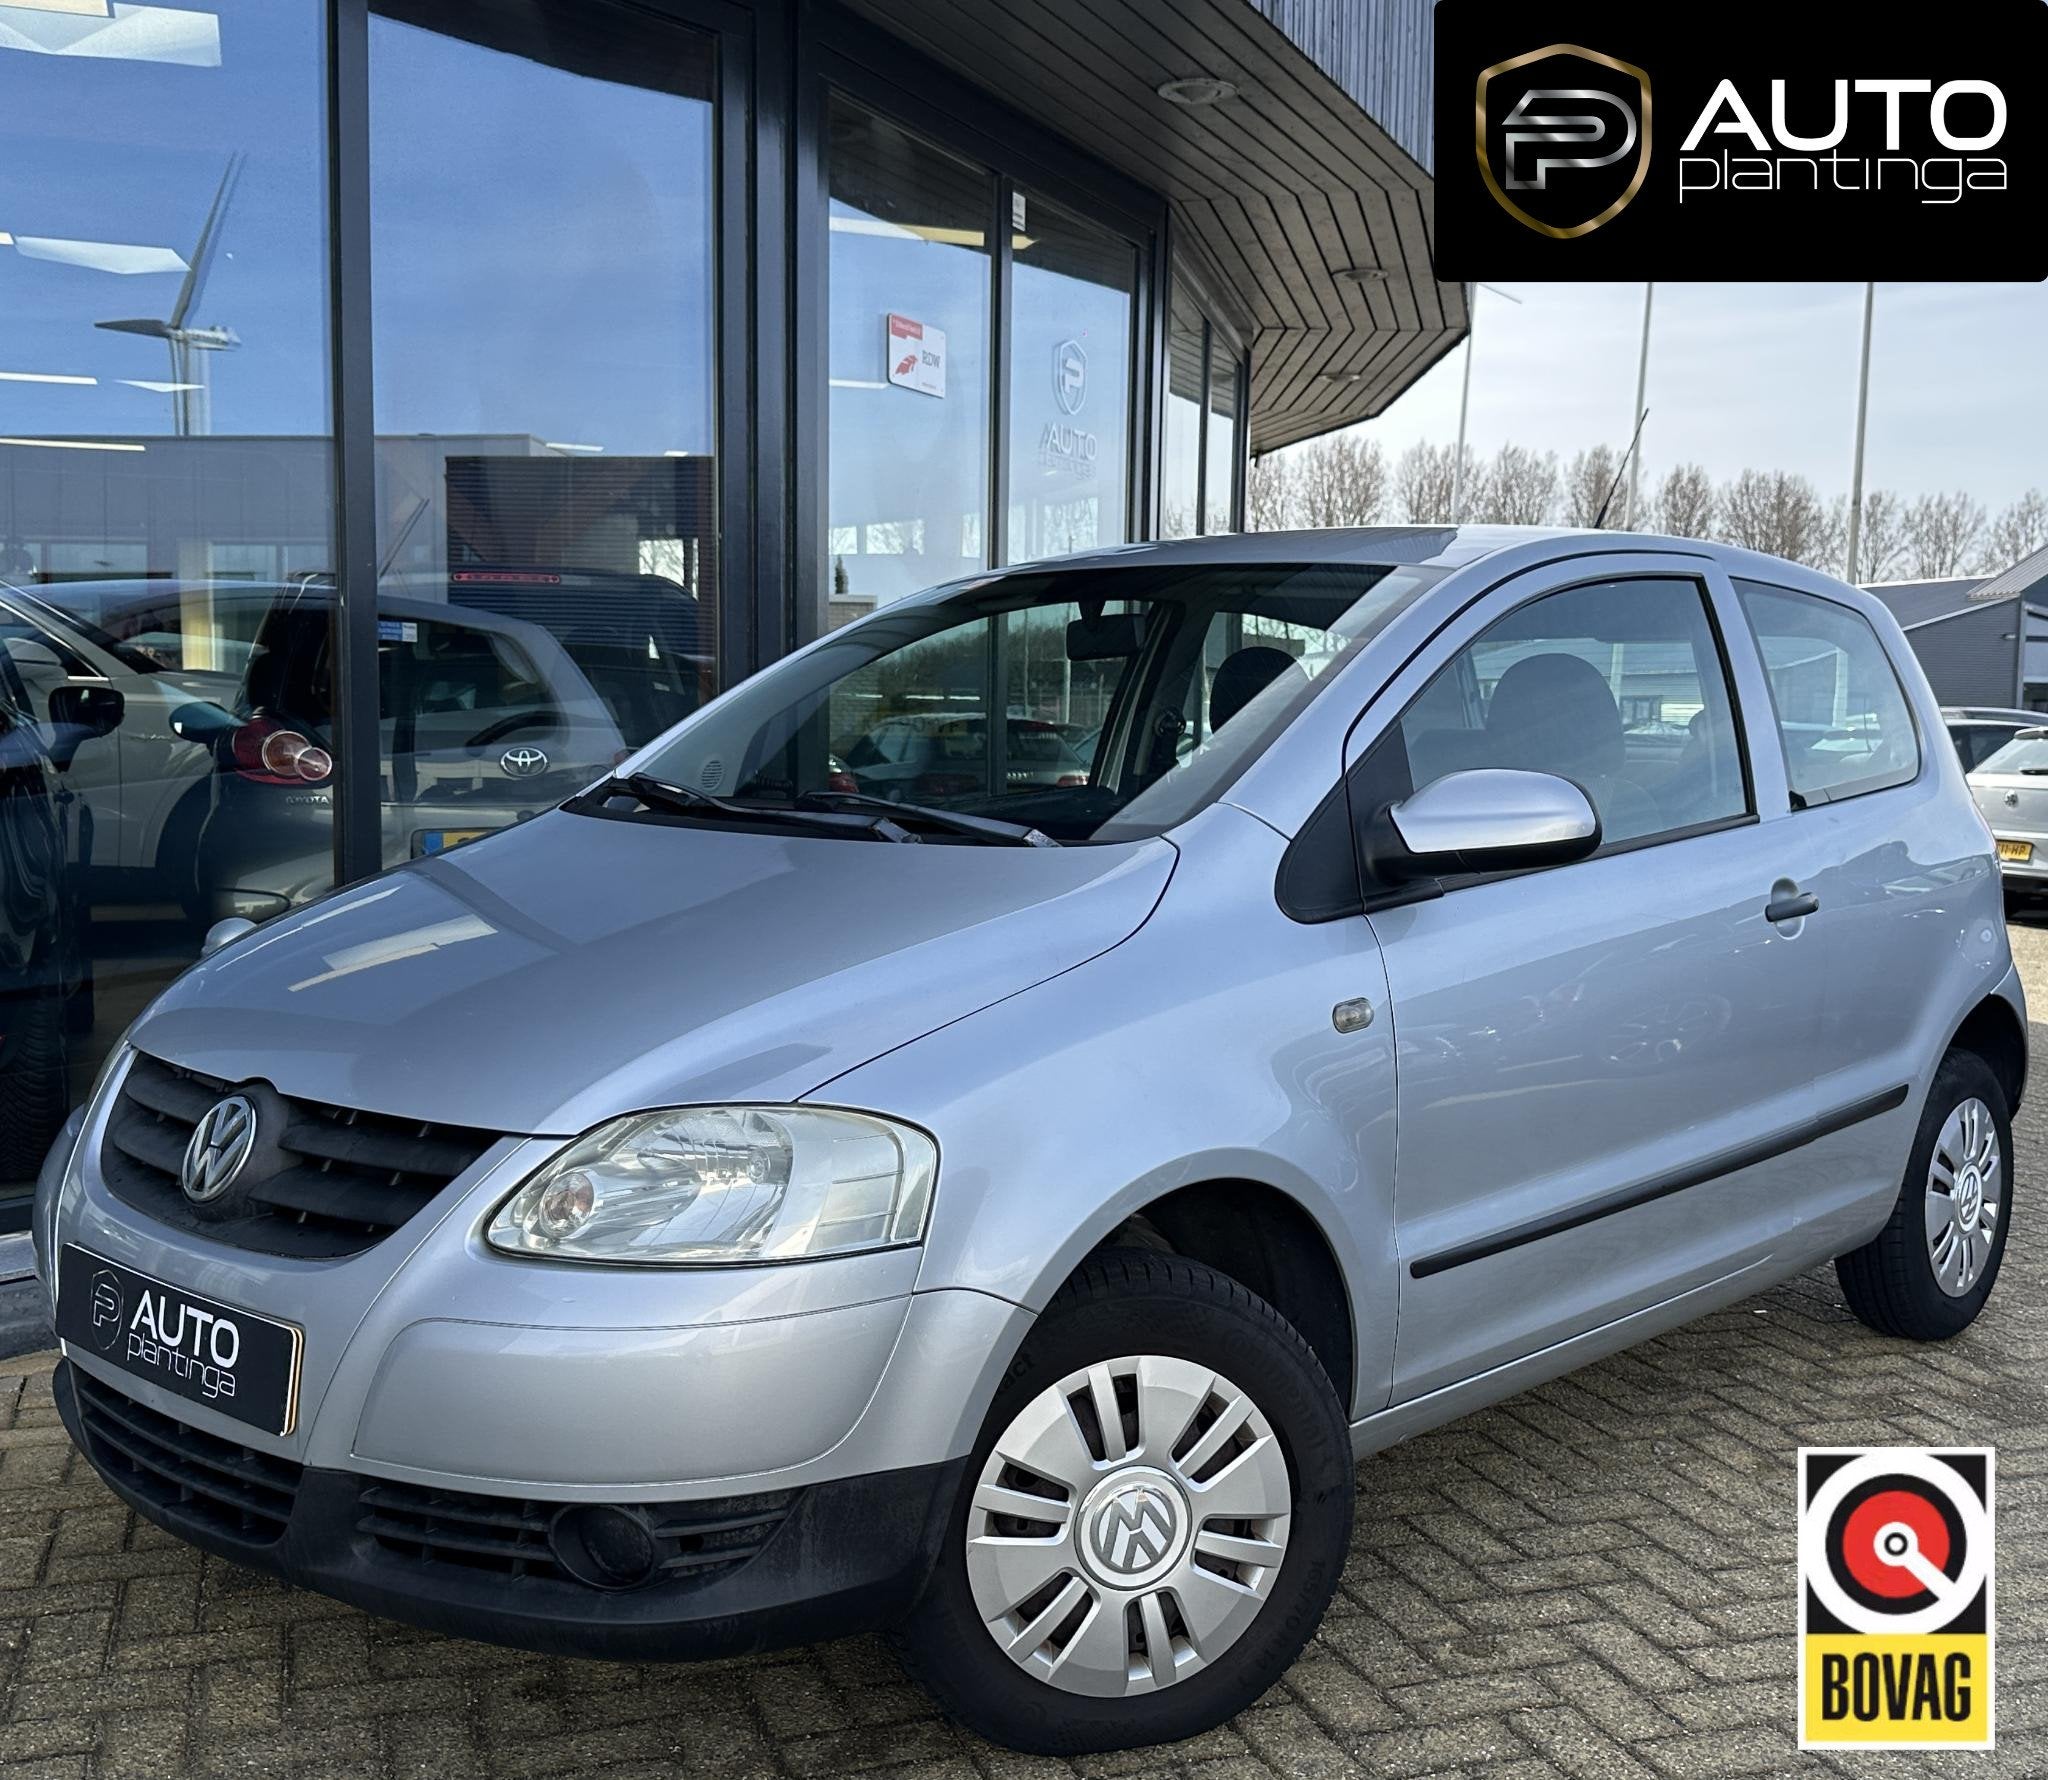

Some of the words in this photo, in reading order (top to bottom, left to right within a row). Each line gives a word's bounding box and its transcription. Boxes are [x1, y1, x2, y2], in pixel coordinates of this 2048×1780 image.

[921, 349, 941, 368] RDW
[1047, 422, 1097, 461] AUTO
[130, 1289, 240, 1369] AUTO
[127, 1330, 236, 1398] plantinga
